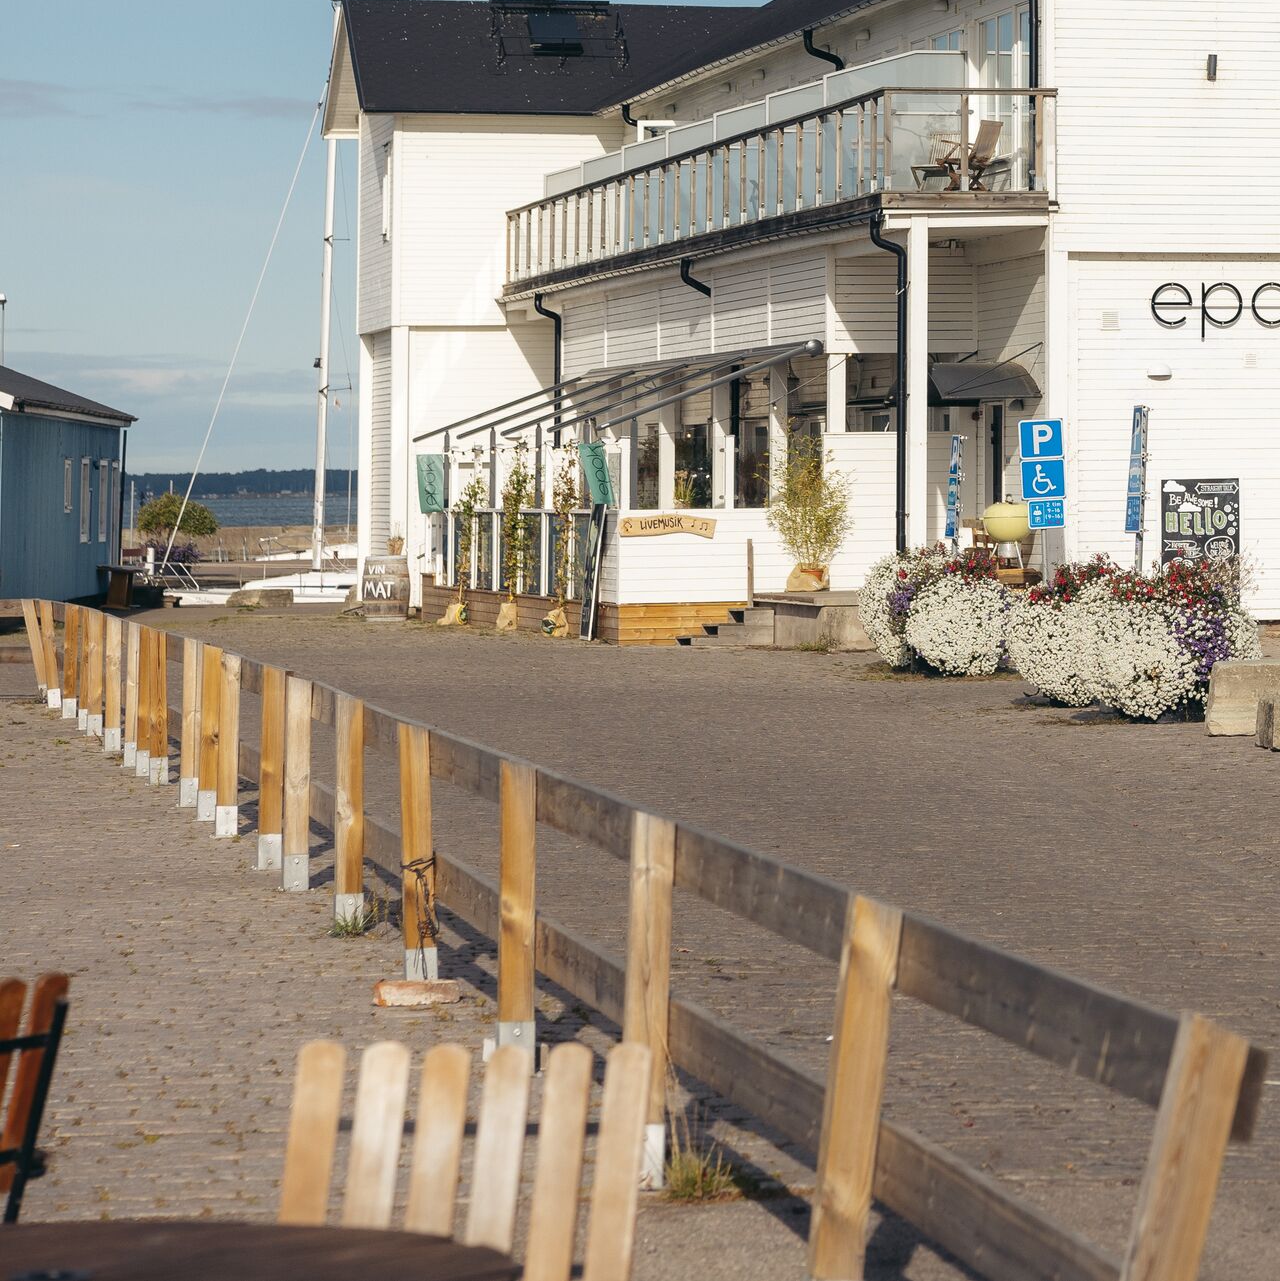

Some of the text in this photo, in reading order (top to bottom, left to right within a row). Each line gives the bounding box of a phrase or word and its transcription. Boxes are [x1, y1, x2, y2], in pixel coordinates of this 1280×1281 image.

[1032, 424, 1053, 455] P
[586, 445, 611, 496] epok
[1165, 507, 1228, 535] HELLO
[368, 564, 386, 575] VIN
[364, 581, 395, 599] MAT
